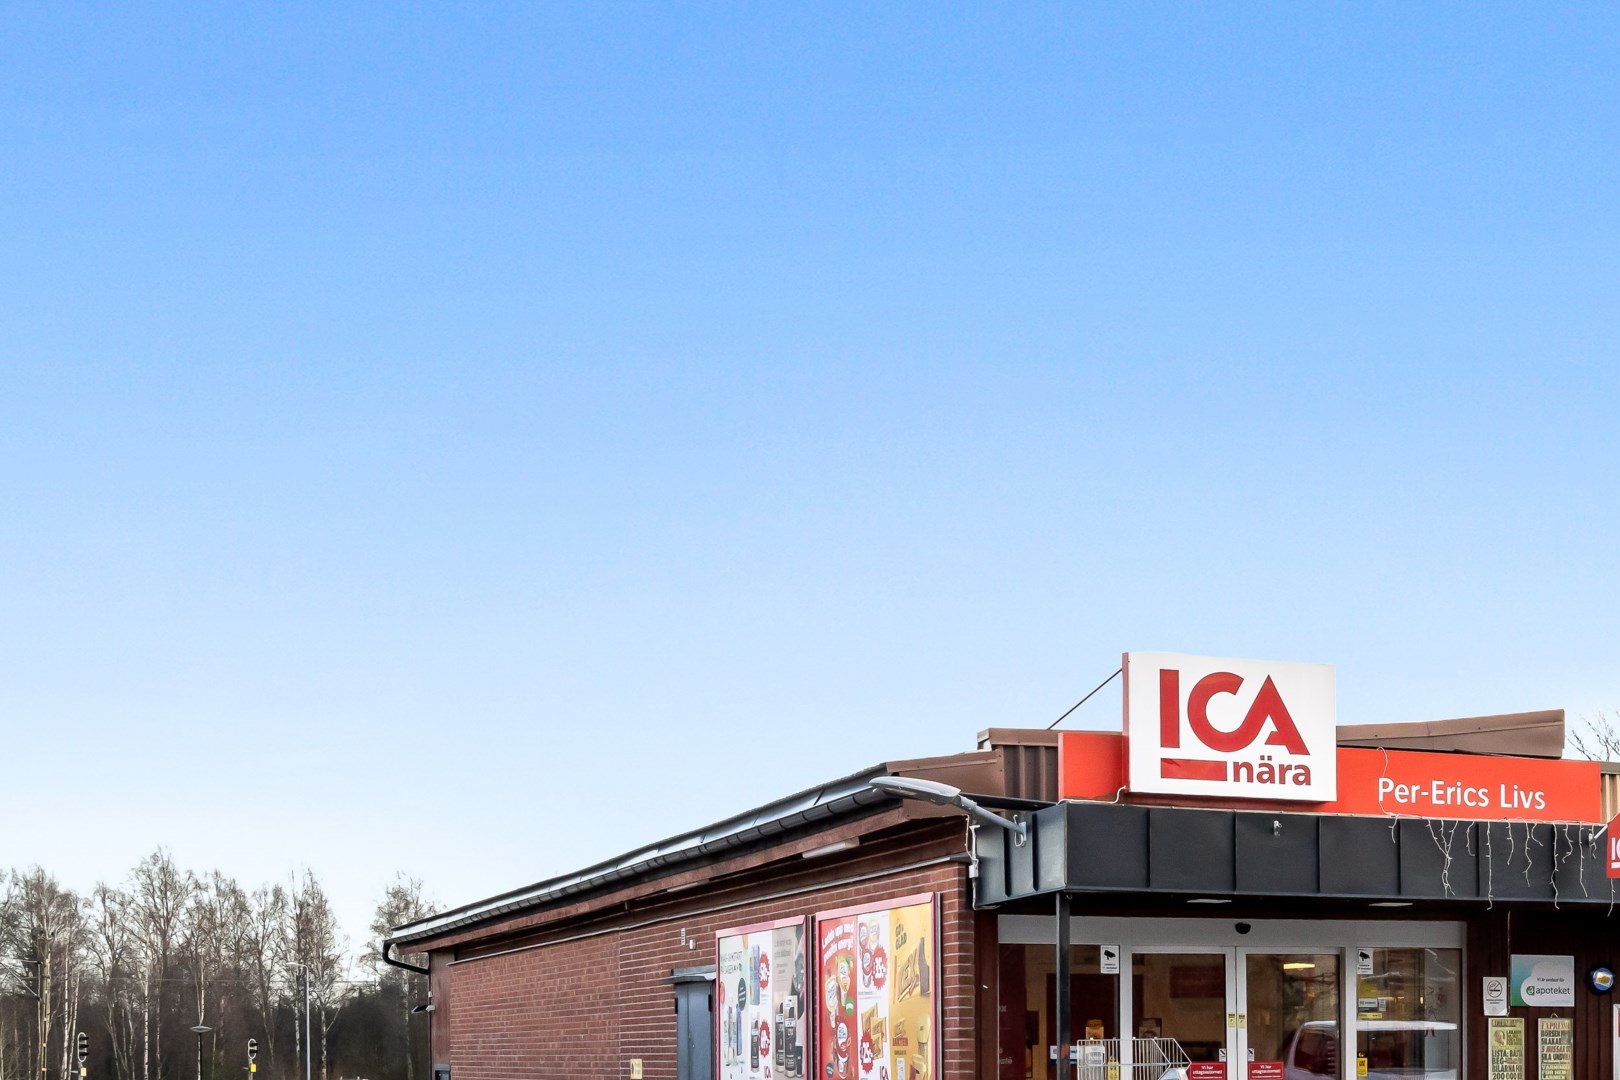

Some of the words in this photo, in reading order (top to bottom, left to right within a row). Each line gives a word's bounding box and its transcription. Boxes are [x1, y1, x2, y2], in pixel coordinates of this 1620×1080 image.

[1160, 669, 1310, 755] ICA
[1233, 755, 1311, 786] nära
[1378, 777, 1489, 807] Per-Erics
[1500, 784, 1546, 810] Livs
[1536, 987, 1570, 995] apoteket
